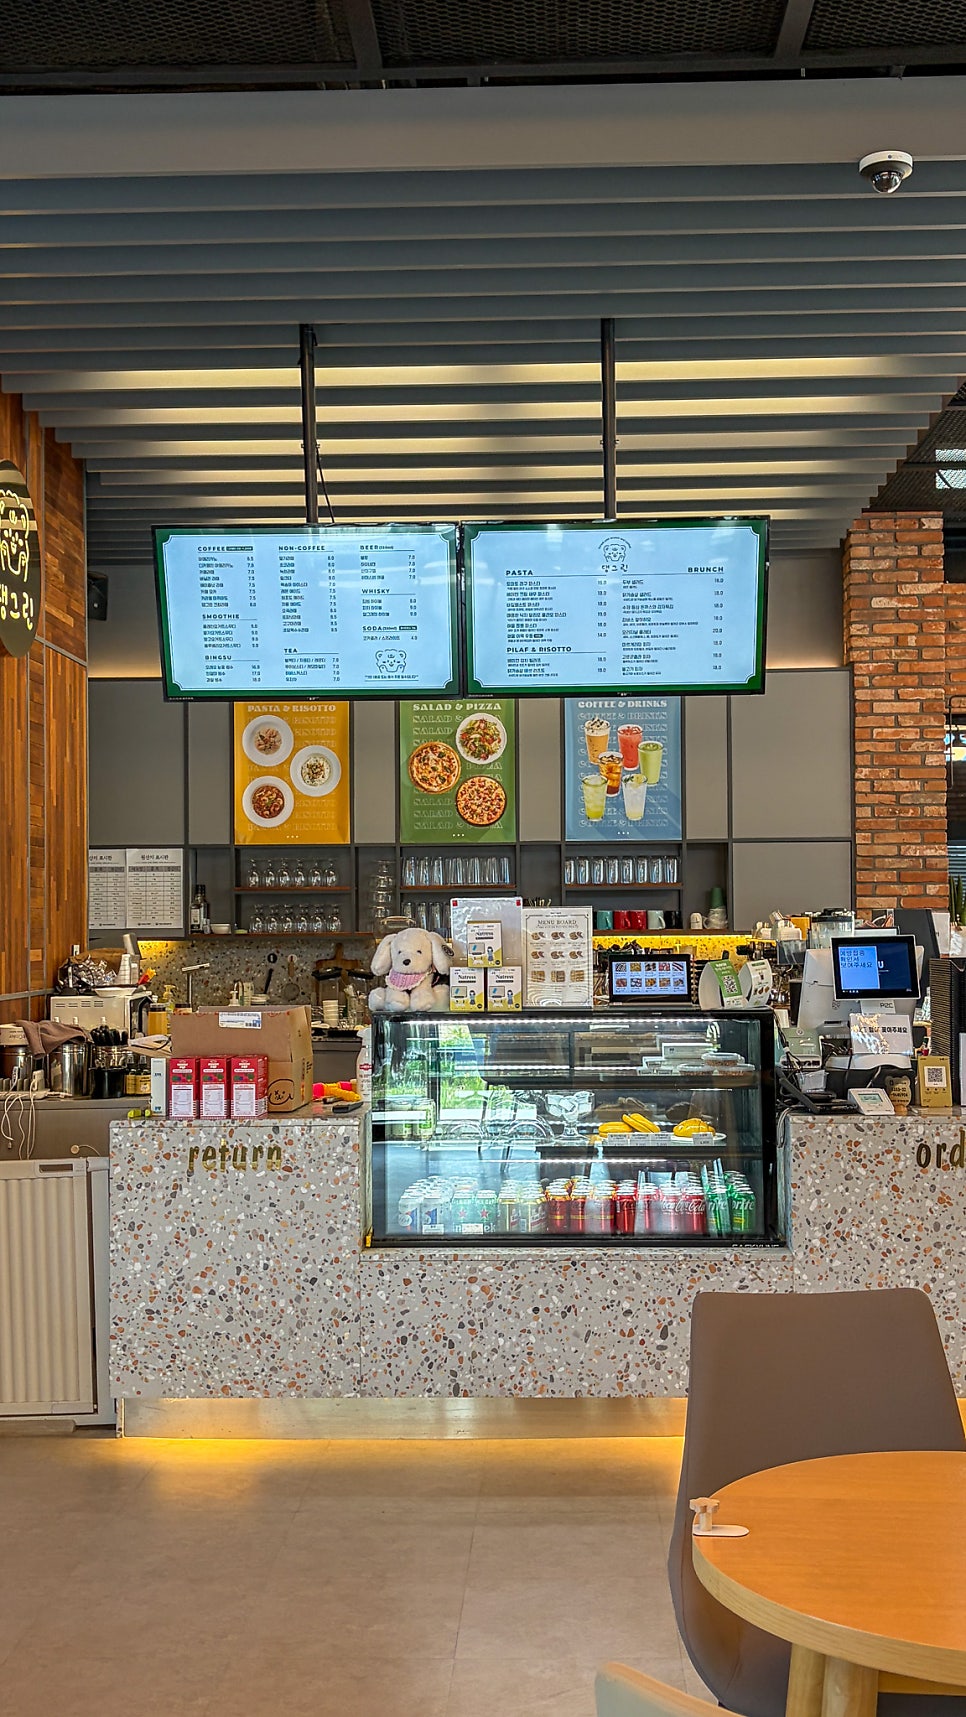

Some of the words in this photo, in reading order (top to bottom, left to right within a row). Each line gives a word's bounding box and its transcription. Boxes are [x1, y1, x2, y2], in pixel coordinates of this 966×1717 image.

[601, 564, 628, 573] 댕그린
[413, 703, 452, 711] SALAD
[627, 700, 667, 708] DRINKS
[916, 1126, 965, 1169] ord
[188, 1139, 281, 1172] return
